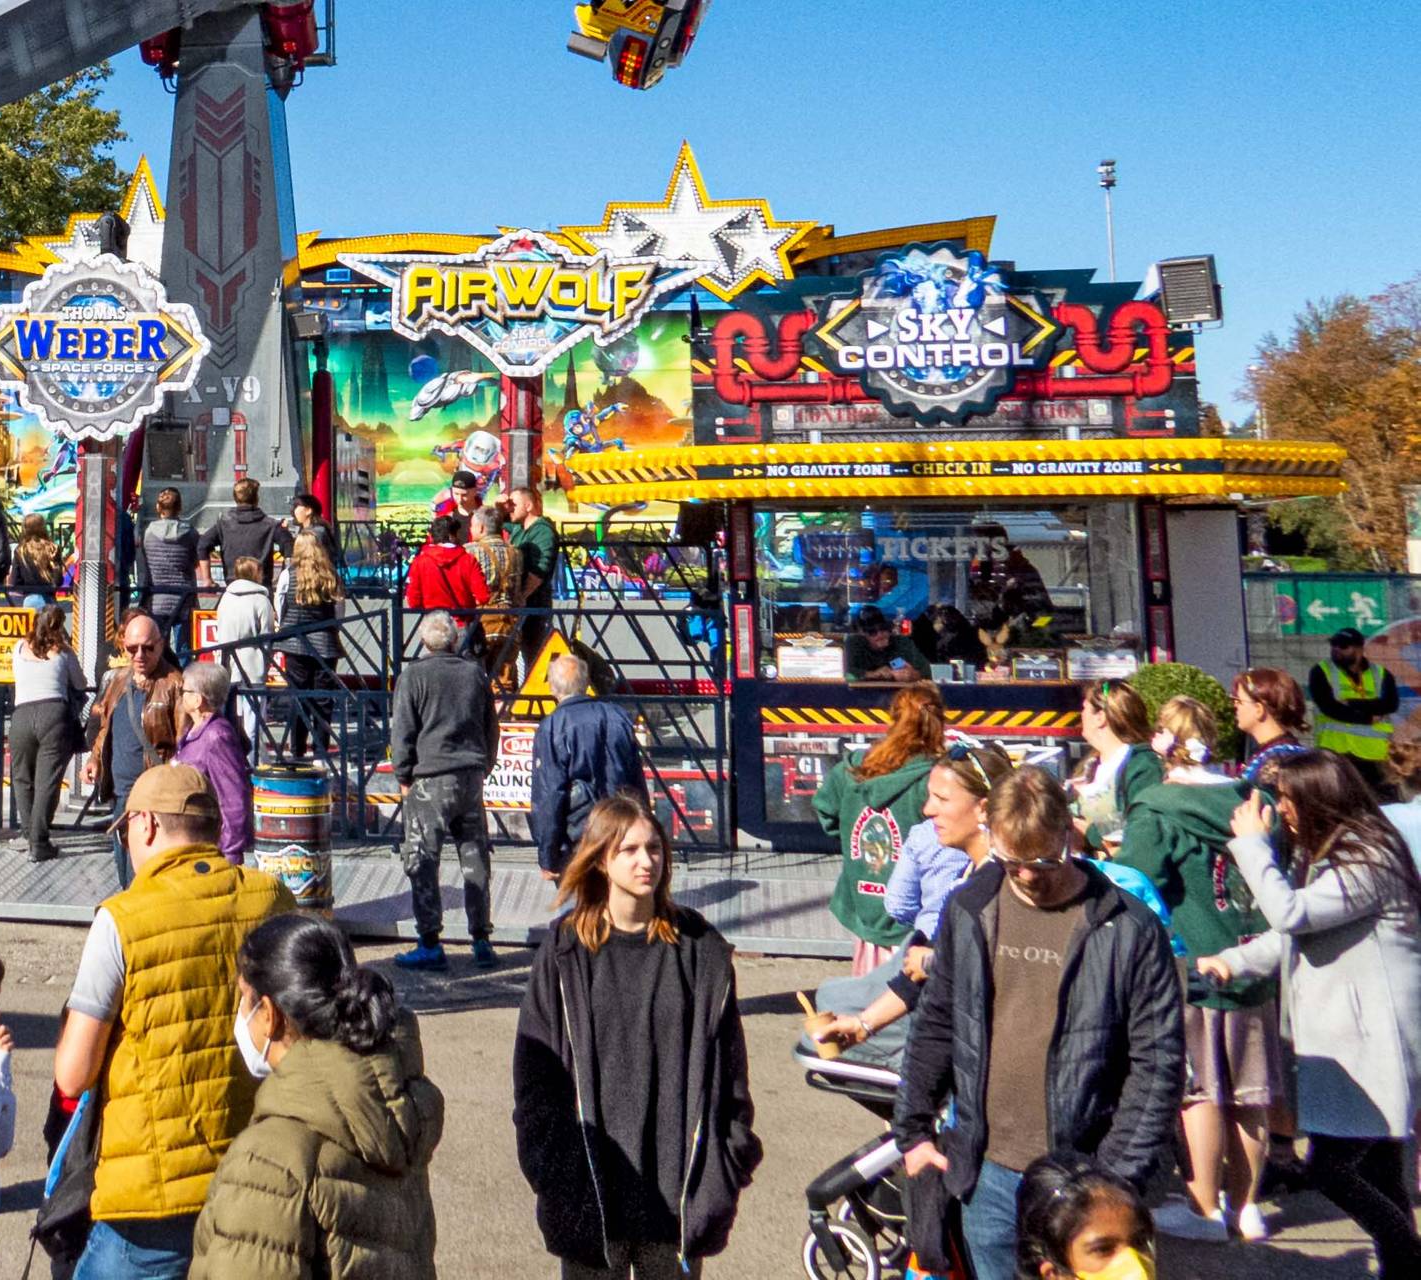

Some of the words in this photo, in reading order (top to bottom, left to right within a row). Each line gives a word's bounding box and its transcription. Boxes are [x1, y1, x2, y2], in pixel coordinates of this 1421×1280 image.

[407, 265, 647, 321] AIRWOLF
[62, 305, 127, 321] THOMAS
[897, 308, 975, 343] SKY
[15, 319, 168, 361] WEBER
[838, 343, 1034, 368] CONTROL
[41, 363, 90, 373] SPACE
[94, 363, 145, 373] FORCE
[766, 465, 788, 476] NO
[790, 465, 851, 476] GRAVITY
[853, 464, 891, 475] ZONE
[912, 462, 967, 475] CHECK
[970, 462, 991, 474] IN
[1012, 462, 1035, 474] NO
[1037, 462, 1100, 474] GRAVITY
[1103, 462, 1143, 473] ZONE
[878, 536, 1010, 562] TICKETS
[998, 945, 1020, 959] re
